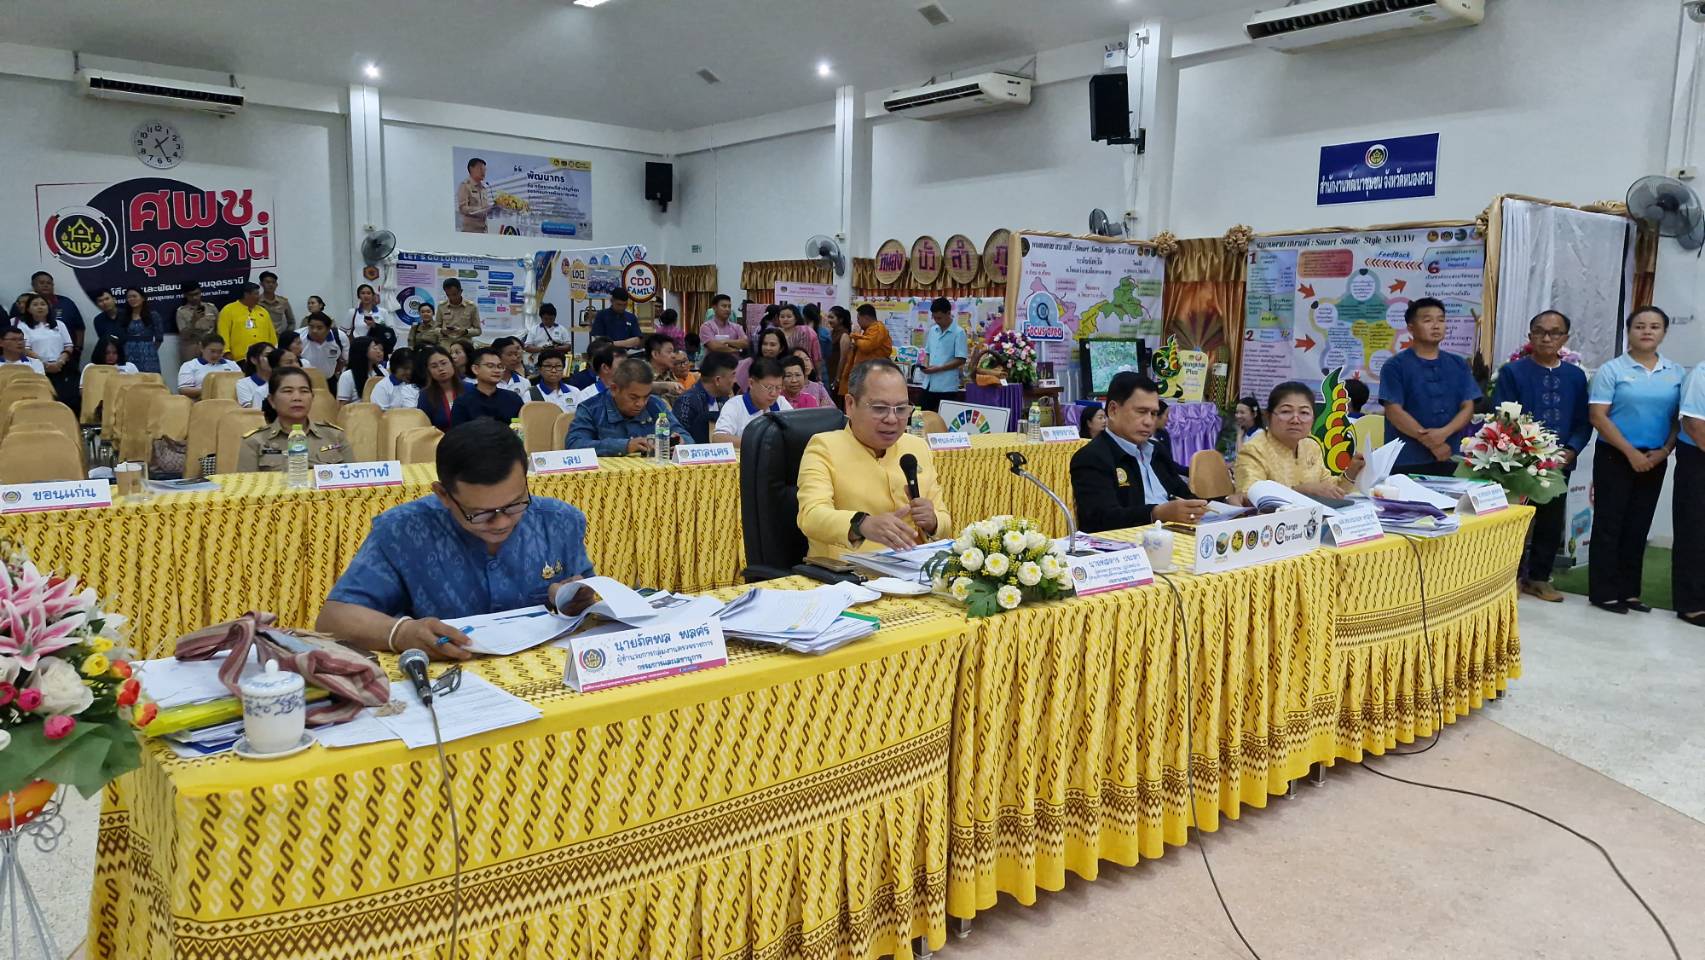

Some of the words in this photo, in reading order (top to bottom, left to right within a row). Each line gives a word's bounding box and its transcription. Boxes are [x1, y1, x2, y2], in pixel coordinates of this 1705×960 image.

[527, 170, 566, 183] พัฒนากร
[1320, 172, 1383, 198] สำนักงานพัฒนาชุมชน
[1383, 167, 1434, 190] จังหวัดหนองคาย
[129, 188, 270, 232] ศพช.
[1315, 238, 1337, 246] Smart
[1339, 237, 1360, 246] Smile
[1363, 236, 1382, 246] Style
[1385, 235, 1415, 243] SAYAM
[131, 228, 271, 277] อุดรธานี
[1075, 245, 1090, 253] Smart
[879, 250, 903, 272] หนอง
[918, 240, 936, 271] บัว
[1249, 253, 1257, 265] 1
[1427, 260, 1441, 274] 6
[630, 276, 652, 286] CDD
[627, 285, 655, 295] FAMILY
[1244, 330, 1255, 342] 2
[691, 446, 729, 459] สกลนคร
[562, 454, 582, 466] เลย
[339, 463, 390, 480] บึงกาฬ
[32, 484, 97, 501] ขอนแก่น
[614, 632, 672, 652] นายภัคพล
[679, 622, 711, 639] พลศรี
